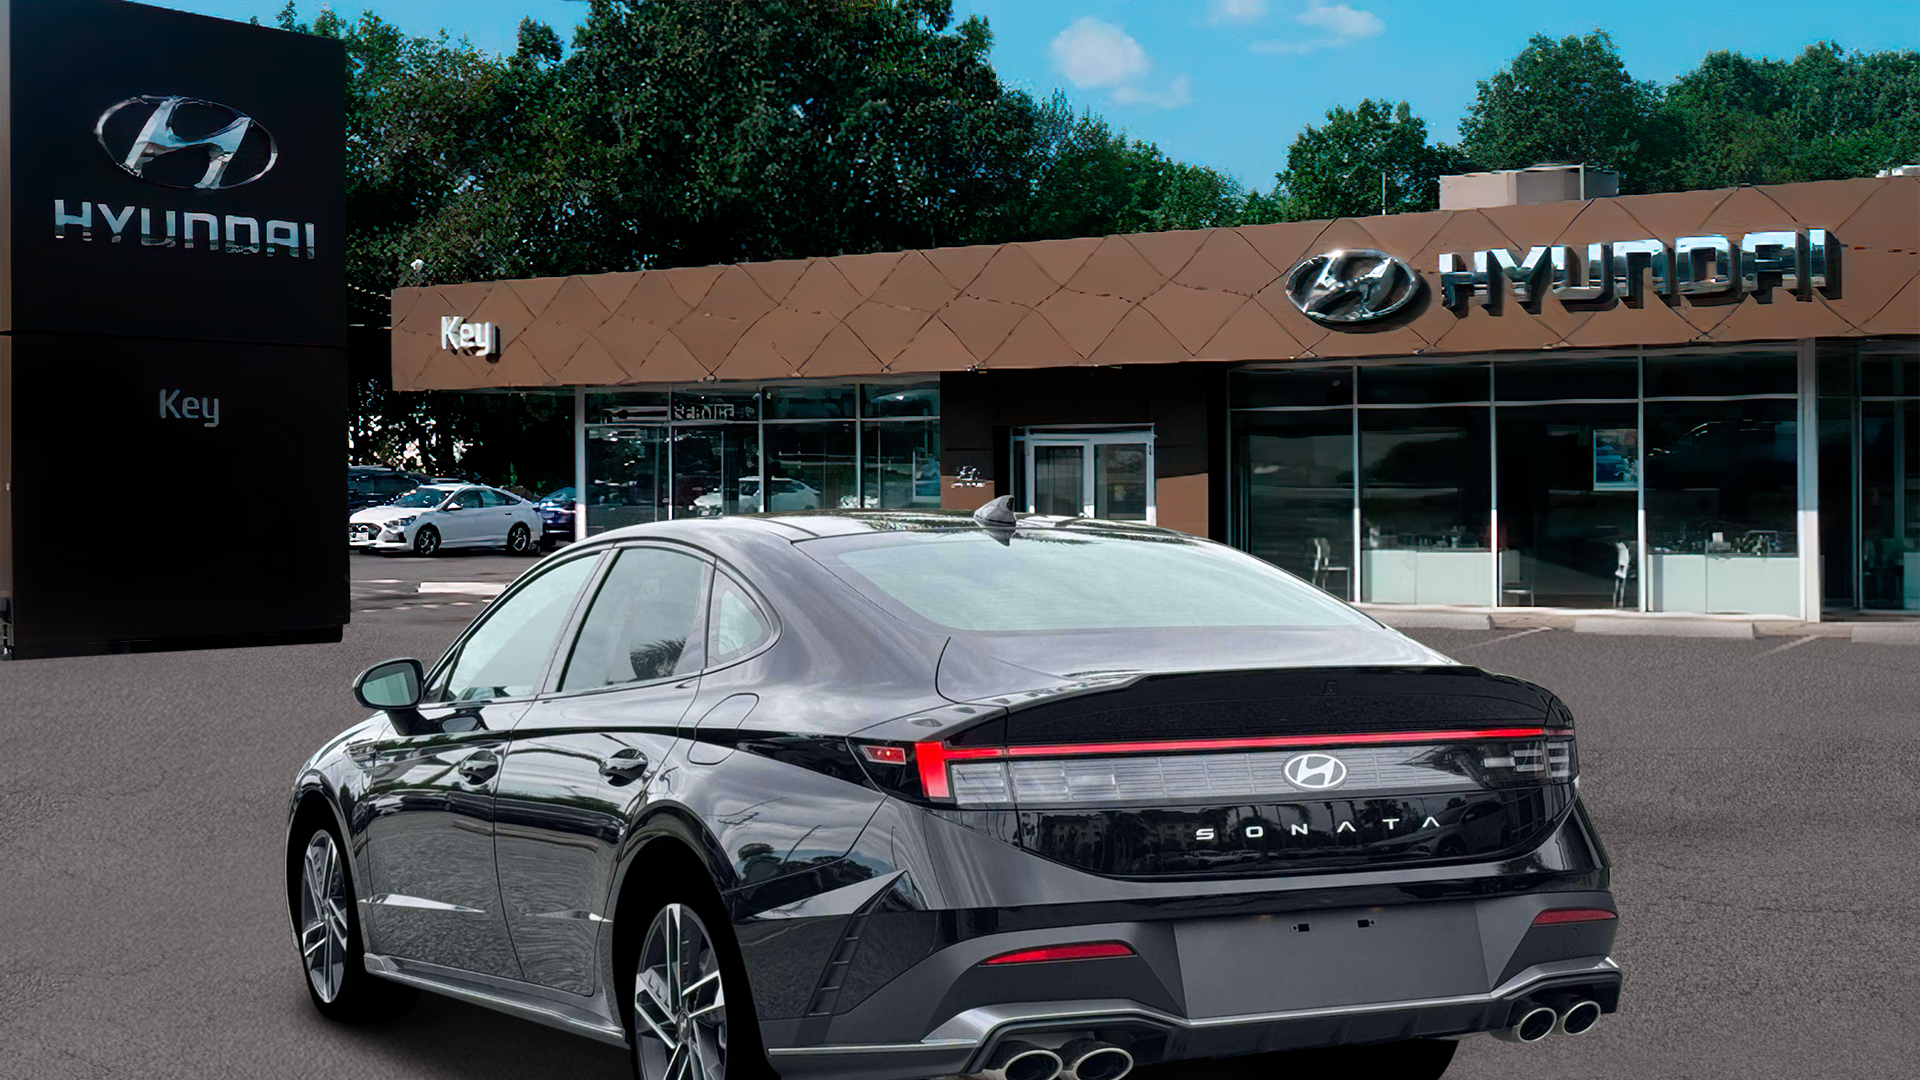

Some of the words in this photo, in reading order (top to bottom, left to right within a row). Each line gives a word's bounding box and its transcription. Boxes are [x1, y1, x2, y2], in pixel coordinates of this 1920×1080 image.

[54, 199, 315, 260] HYUNDAI
[1438, 228, 1838, 314] HYUNDAI
[441, 315, 494, 358] Key
[159, 388, 220, 427] Key
[1196, 816, 1441, 841] SONATA
